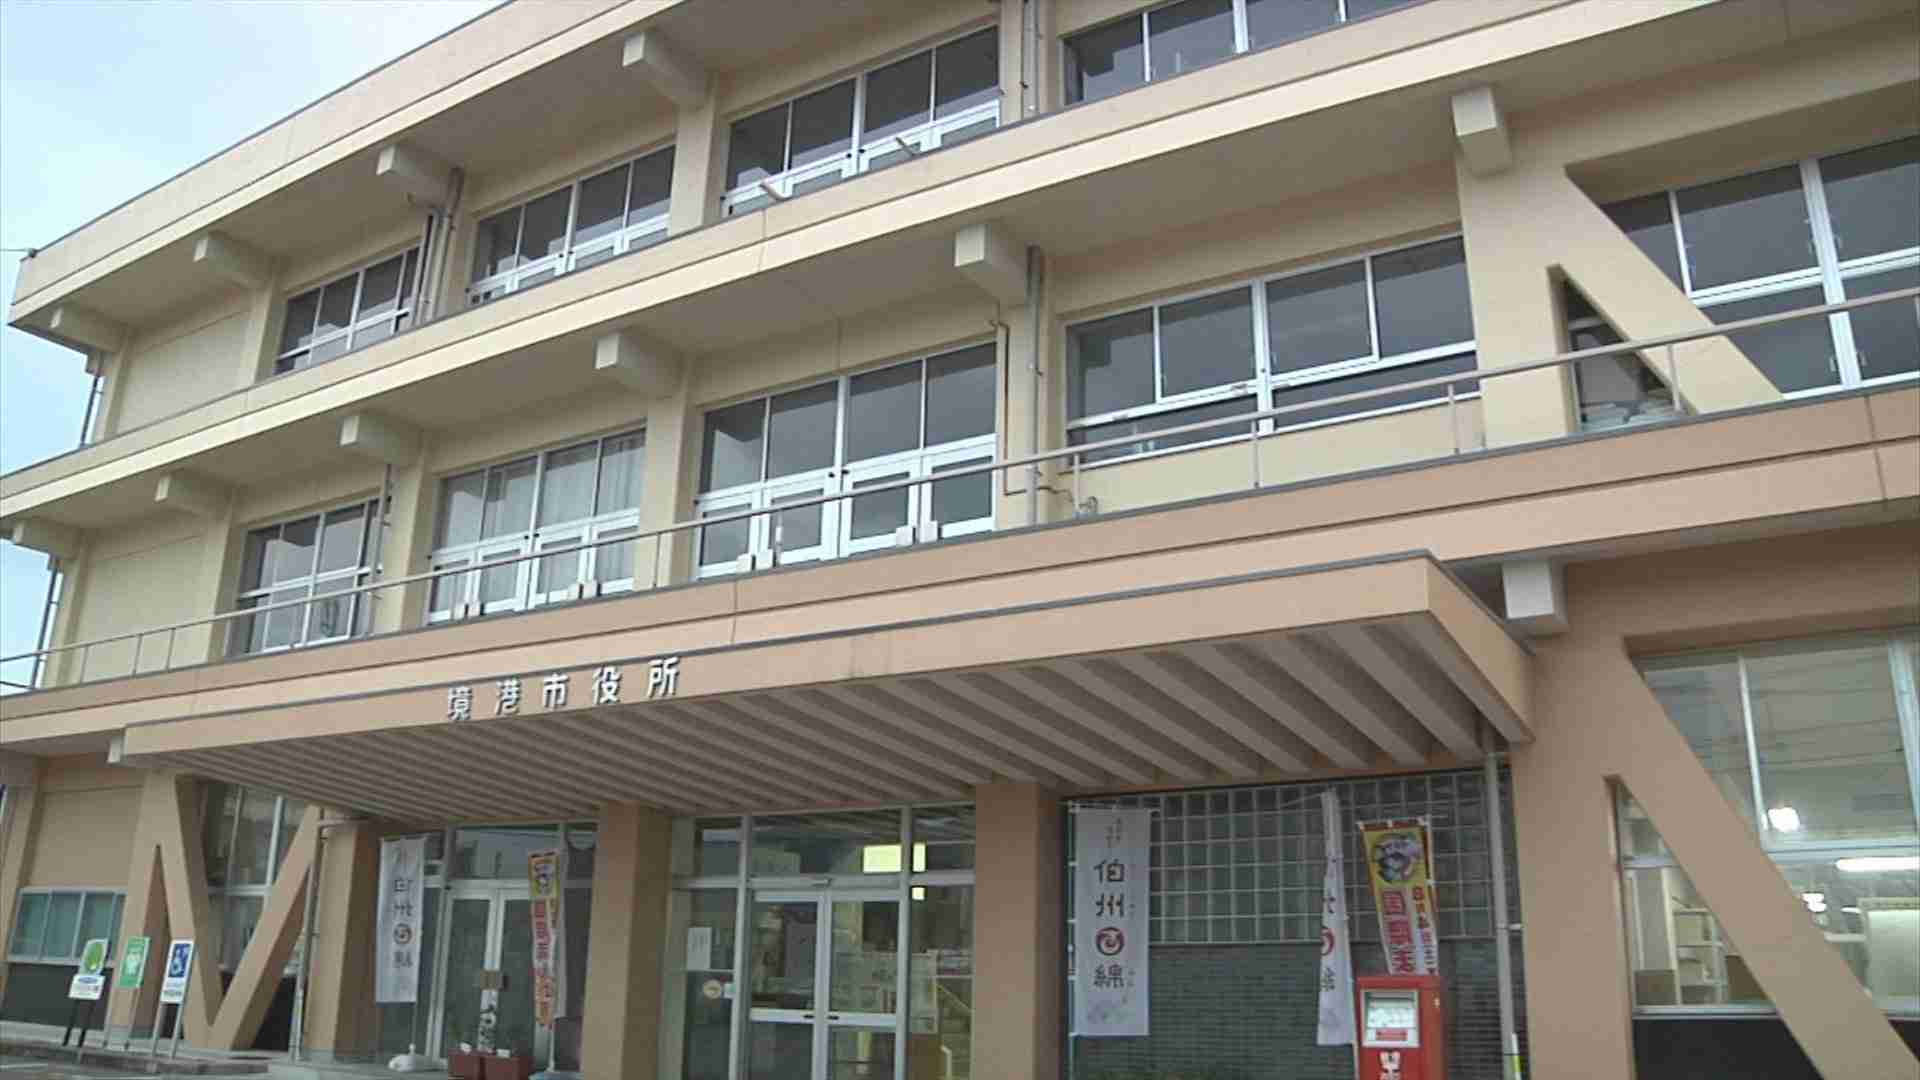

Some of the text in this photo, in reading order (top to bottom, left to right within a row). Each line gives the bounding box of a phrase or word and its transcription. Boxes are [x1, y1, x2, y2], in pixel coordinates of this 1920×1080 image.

[447, 657, 680, 721] 境港市役所
